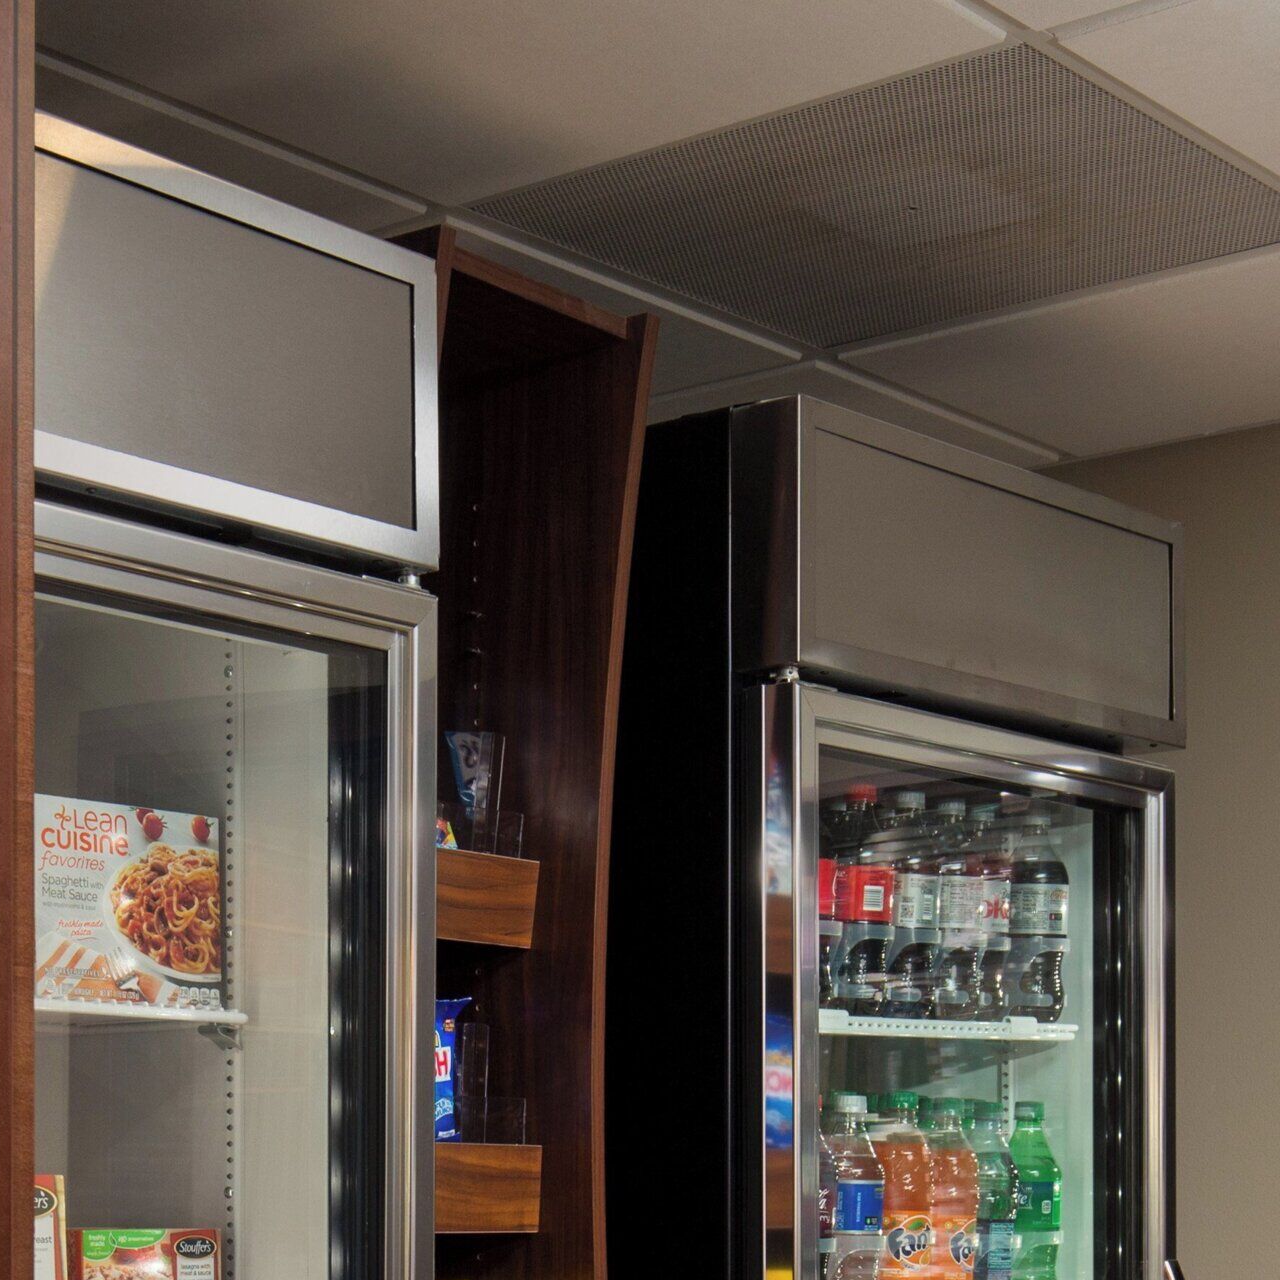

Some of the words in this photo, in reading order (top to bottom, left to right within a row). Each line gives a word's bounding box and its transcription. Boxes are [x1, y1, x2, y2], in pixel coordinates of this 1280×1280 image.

[73, 808, 128, 835] Lean
[38, 850, 105, 871] favorites
[41, 872, 89, 889] Spaghetti
[90, 881, 105, 890] with
[41, 886, 66, 899] Meat
[68, 888, 98, 902] Sauce
